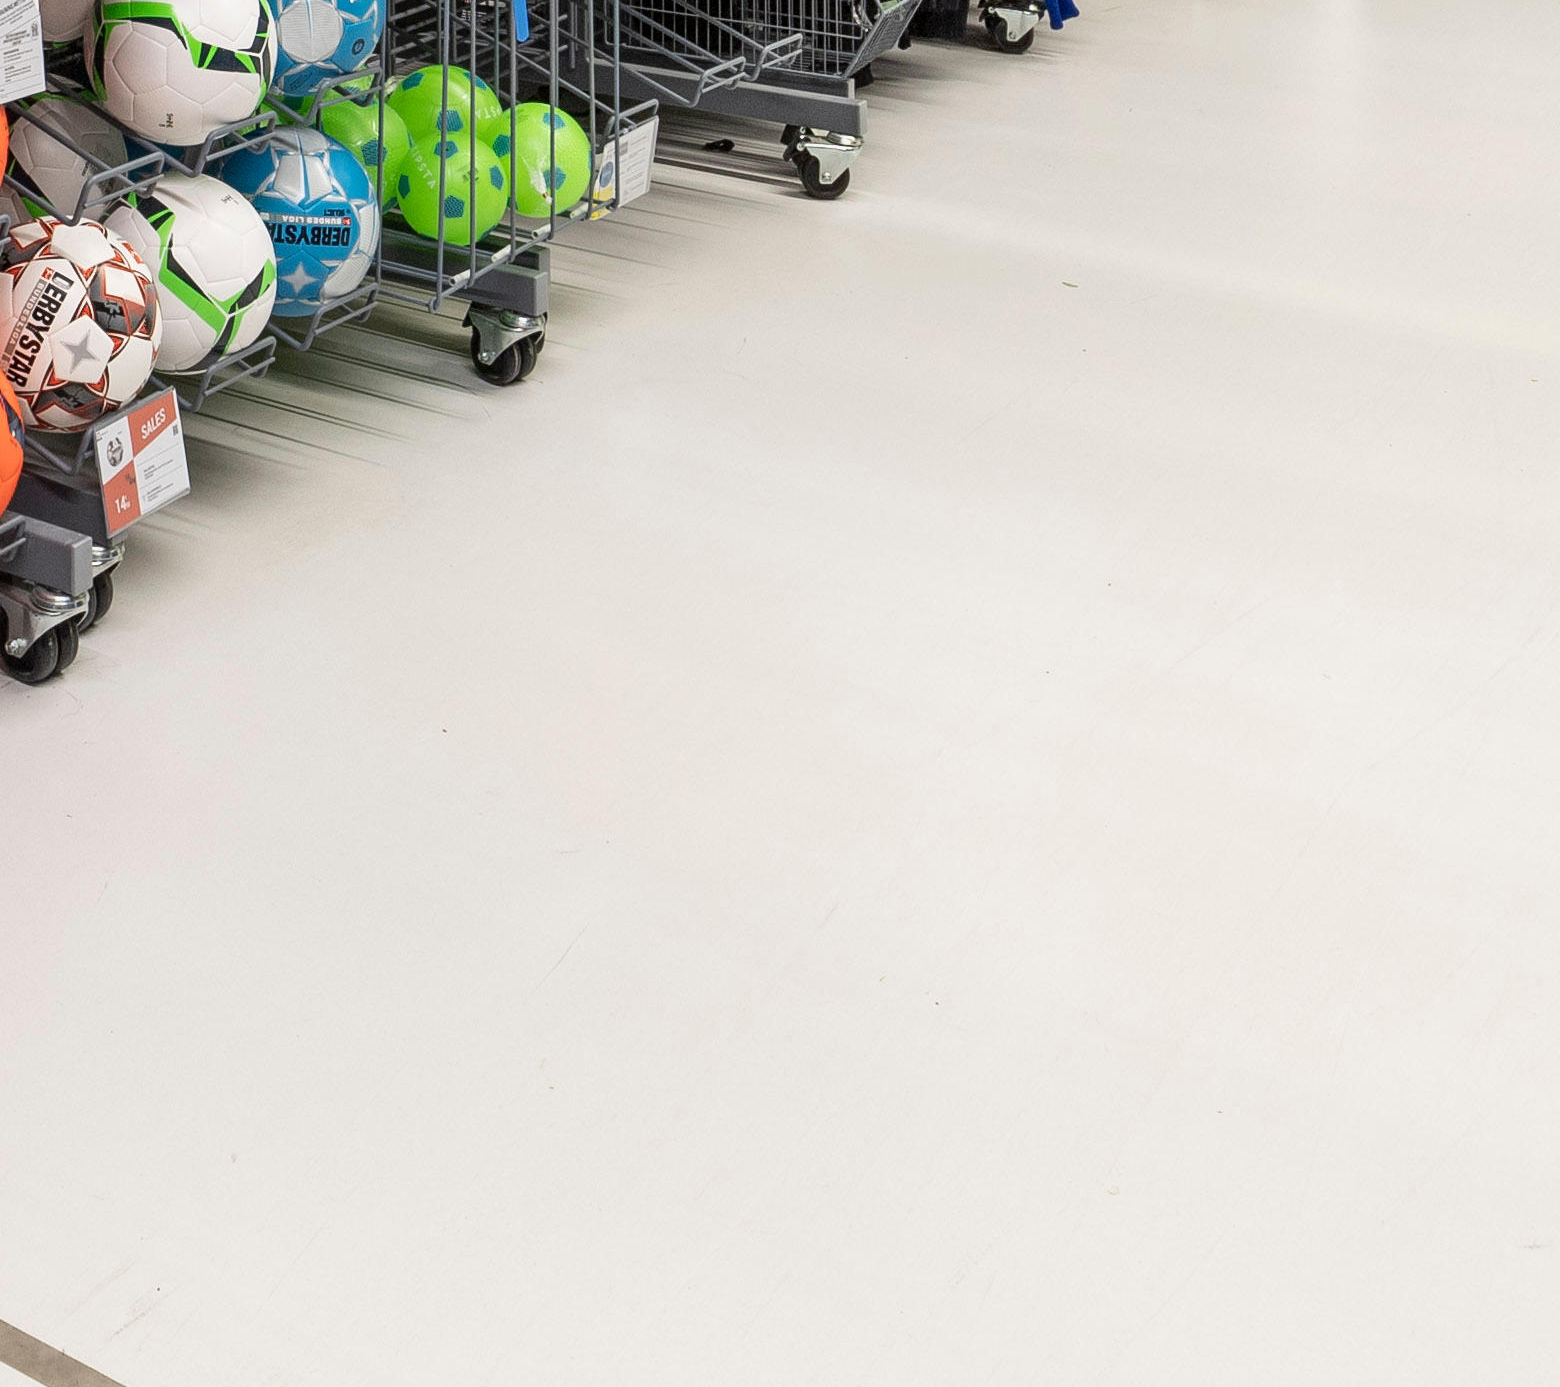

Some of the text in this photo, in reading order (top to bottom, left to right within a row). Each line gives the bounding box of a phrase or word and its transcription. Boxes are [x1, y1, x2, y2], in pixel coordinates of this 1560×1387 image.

[6, 271, 74, 388] DERBYSTAR
[140, 407, 166, 440] SALES
[115, 494, 128, 515] 14
